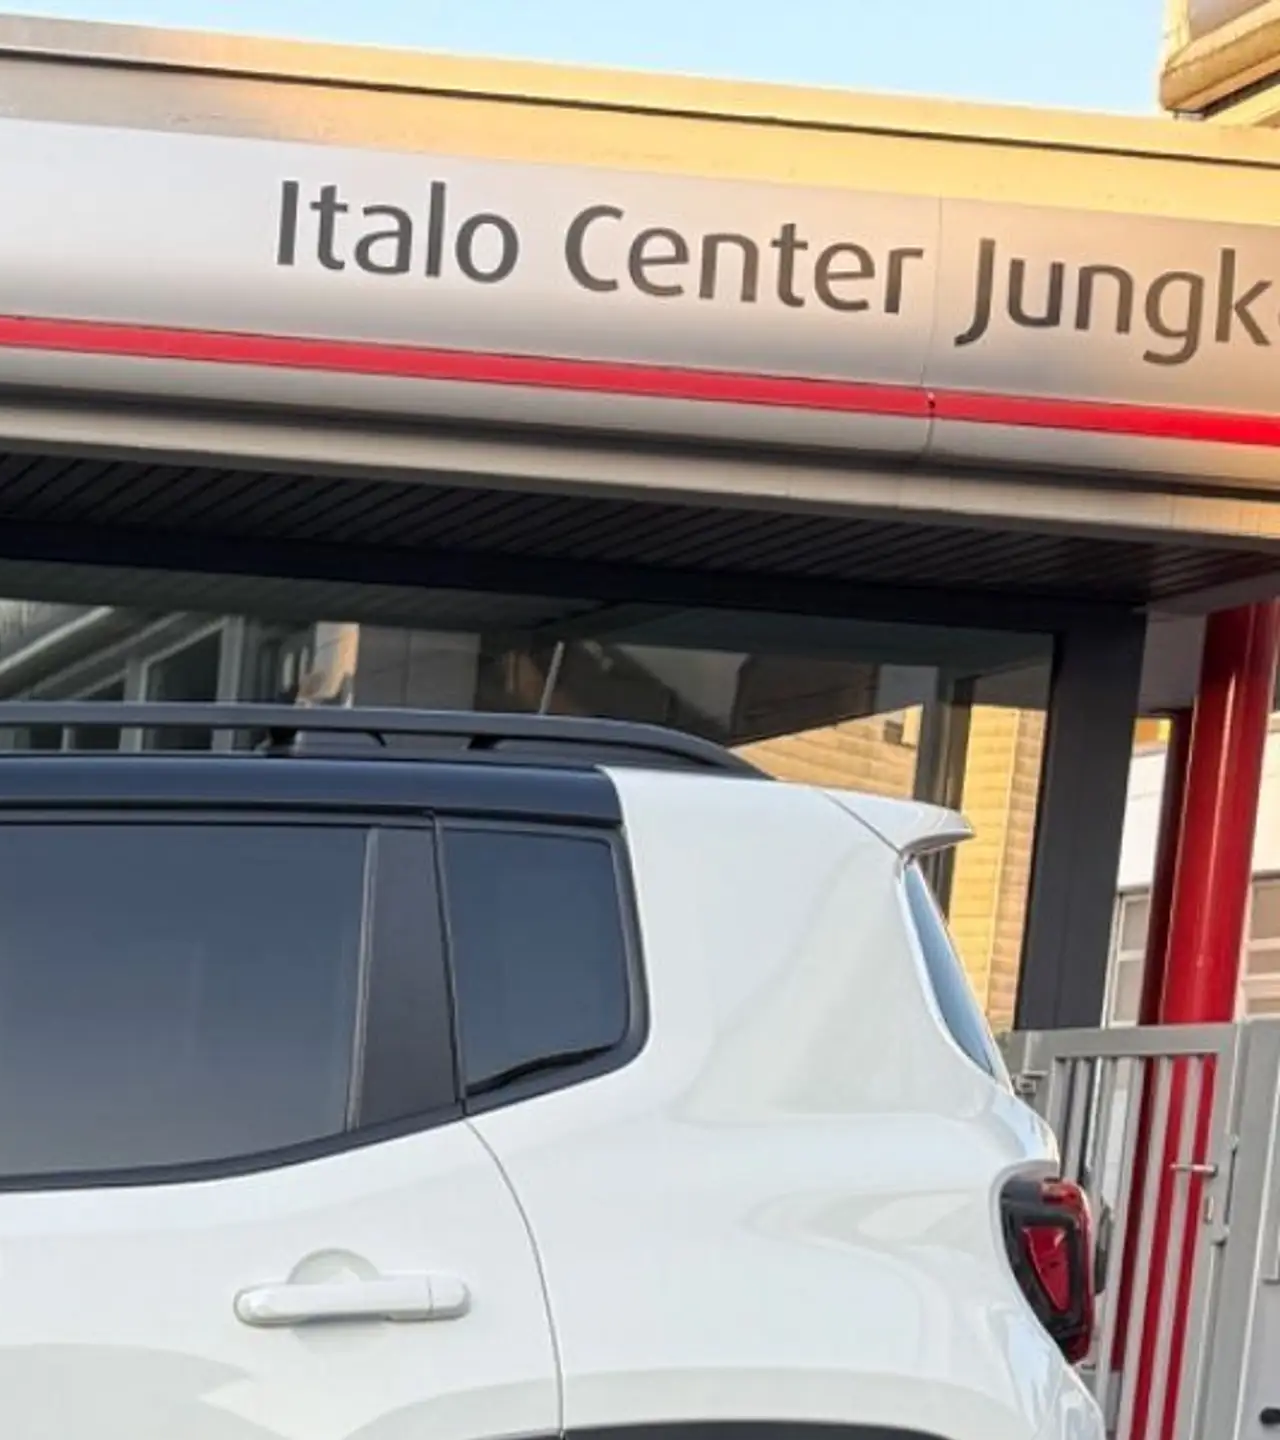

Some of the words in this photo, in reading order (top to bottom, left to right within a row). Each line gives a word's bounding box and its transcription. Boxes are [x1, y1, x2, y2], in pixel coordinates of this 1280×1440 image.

[276, 180, 520, 284] Italo
[563, 204, 925, 315] Center
[953, 237, 1280, 366] Jungk
